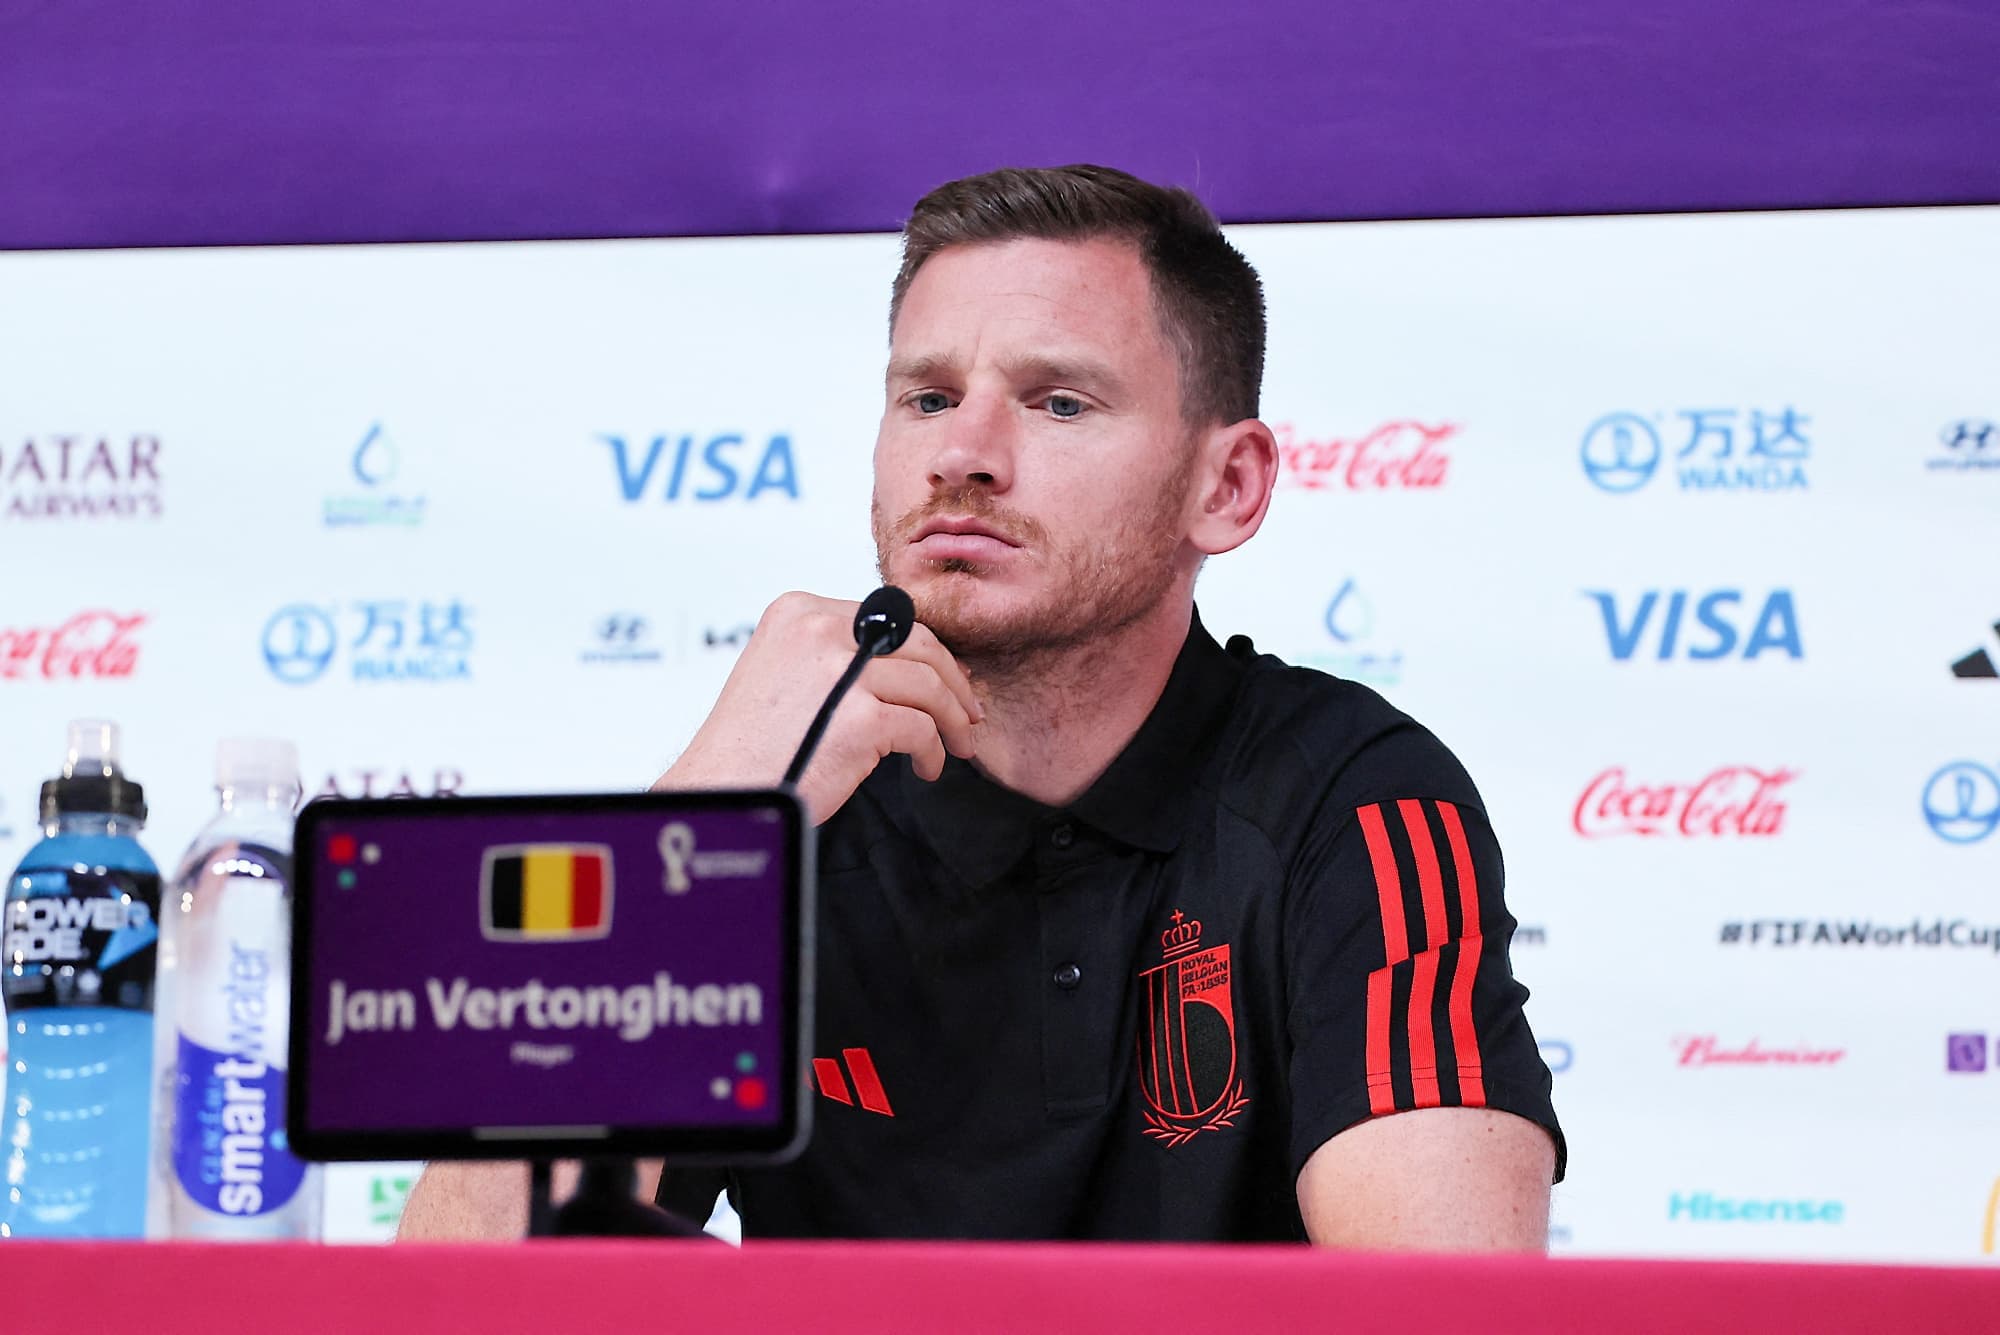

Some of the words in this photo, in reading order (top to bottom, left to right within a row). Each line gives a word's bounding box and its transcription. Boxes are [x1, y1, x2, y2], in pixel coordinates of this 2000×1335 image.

[1677, 406, 1809, 459] 万达
[0, 437, 160, 482] ATAR
[602, 432, 801, 502] VISA
[1678, 467, 1808, 491] WANDA
[1584, 588, 1805, 661] VISA
[1181, 952, 1217, 972] ROYAL
[1181, 960, 1229, 985] BELGIAN
[327, 979, 417, 1044] Jan
[425, 971, 763, 1041] Vertonghen
[1672, 1034, 1846, 1068] Budweiser
[1668, 1192, 1846, 1224] Hisense
